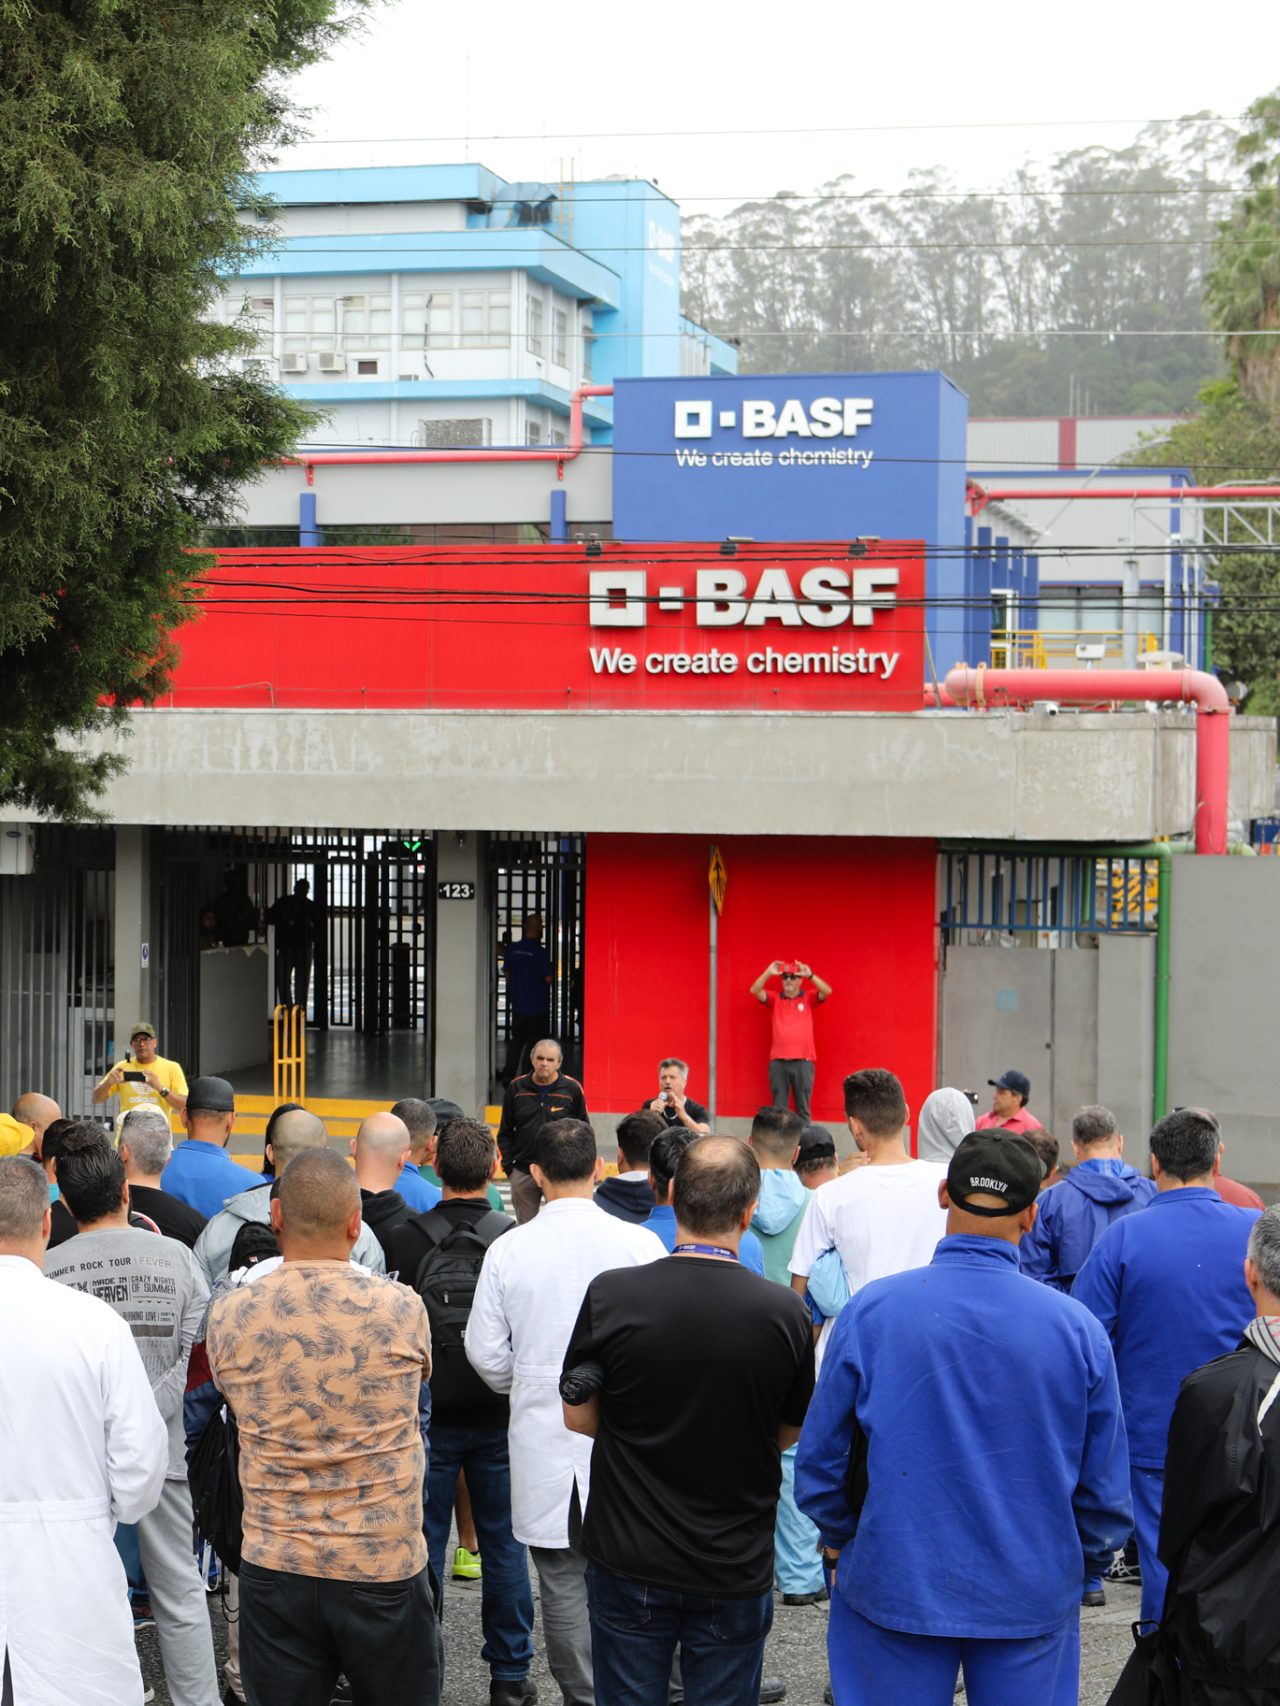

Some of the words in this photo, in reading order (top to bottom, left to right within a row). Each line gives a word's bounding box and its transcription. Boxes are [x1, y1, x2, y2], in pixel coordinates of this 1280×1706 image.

[742, 398, 874, 438] BASF
[676, 449, 707, 468] We
[712, 450, 773, 468] create
[778, 447, 873, 469] chemistry
[696, 567, 900, 627] BASF
[590, 648, 637, 674] We
[645, 650, 738, 674] create
[746, 646, 899, 679] chemistry
[443, 884, 470, 898] 123
[969, 1176, 1009, 1193] BROOKLYN
[80, 1260, 104, 1271] ROCK
[109, 1257, 131, 1267] TOUR
[139, 1256, 171, 1267] FEVER
[92, 1277, 115, 1286] MADE
[119, 1276, 128, 1284] IN
[131, 1275, 151, 1283] CRAZY
[154, 1276, 176, 1286] NIGHTS
[92, 1284, 129, 1303] HEAVEN
[131, 1284, 141, 1293] OF
[144, 1283, 177, 1296] SUMMER
[145, 1311, 157, 1322] LOVE
